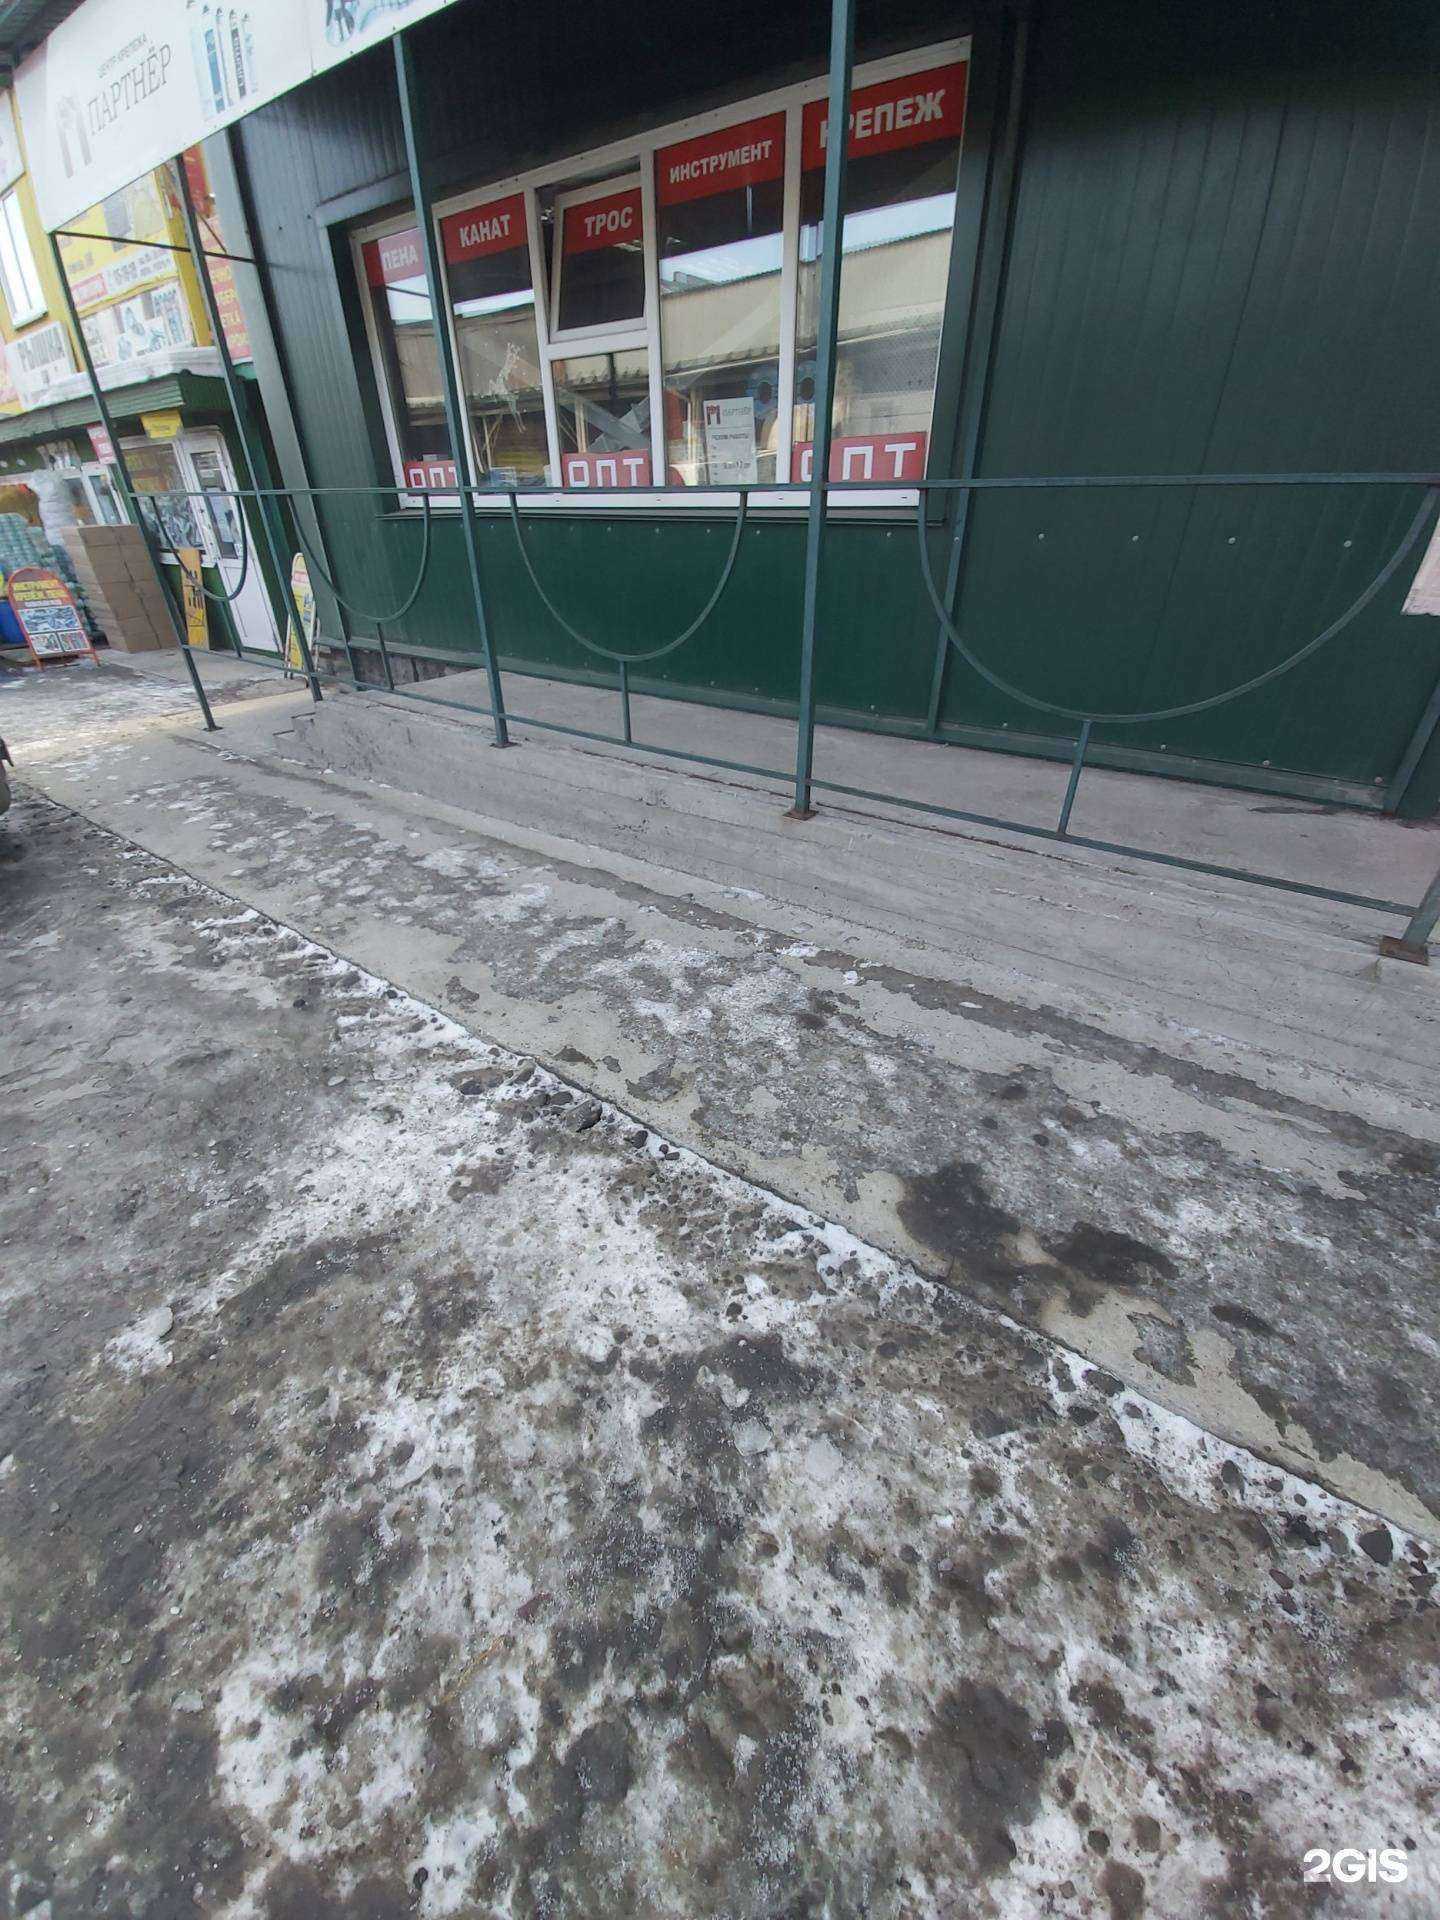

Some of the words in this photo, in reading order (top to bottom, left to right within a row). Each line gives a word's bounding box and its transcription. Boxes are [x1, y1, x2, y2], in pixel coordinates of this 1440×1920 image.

[88, 44, 171, 136] ПАРТНЁР
[819, 88, 946, 149] ЕПЕЖ
[669, 140, 773, 184] ИНСТРУМЕНТ
[459, 214, 511, 248] КАНАТ
[584, 206, 633, 238] ТРОС
[382, 244, 419, 271] ПЕНА
[568, 457, 644, 488] ОПТ
